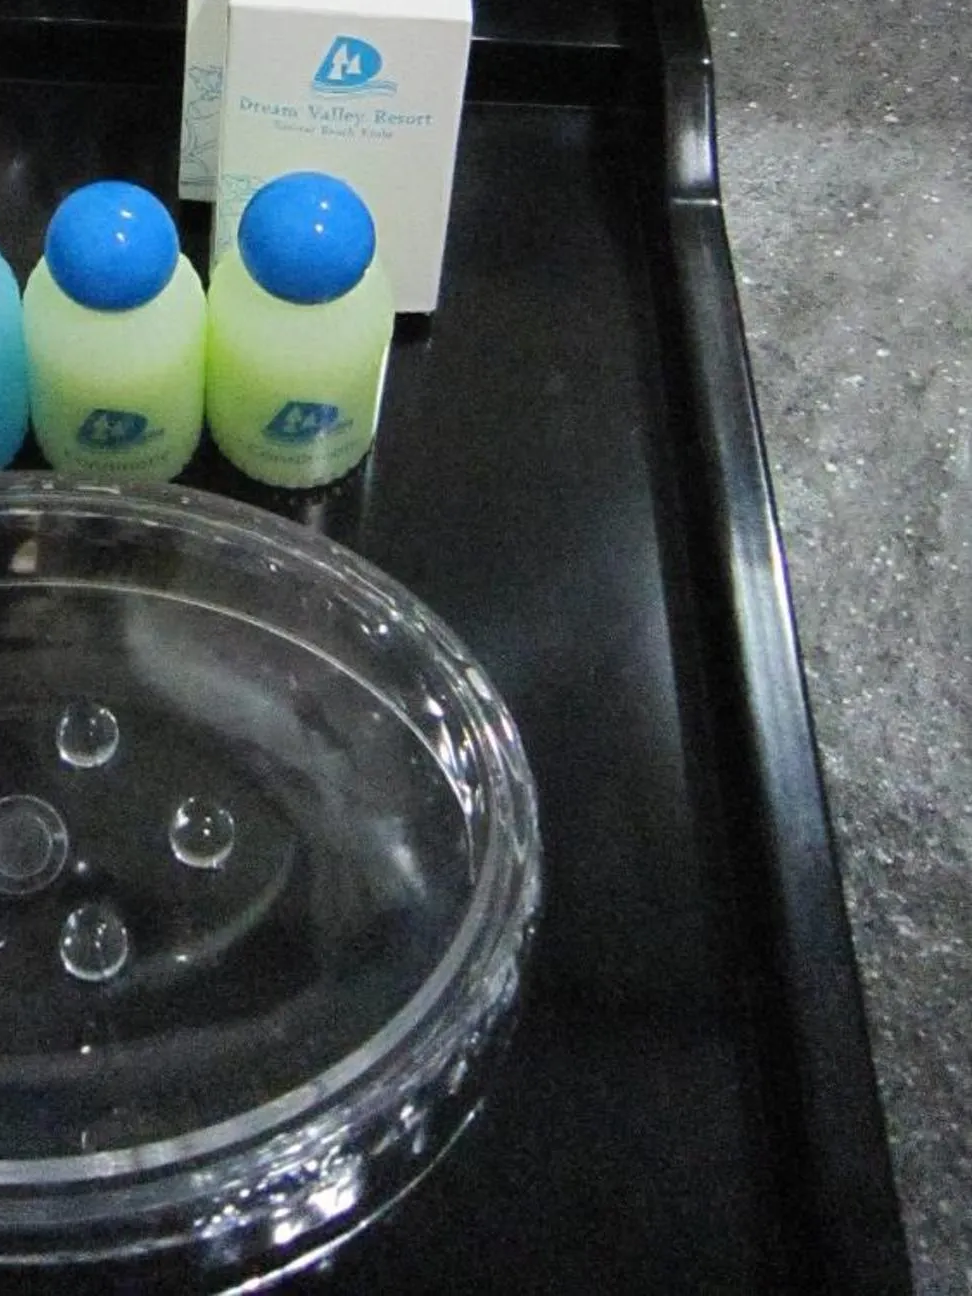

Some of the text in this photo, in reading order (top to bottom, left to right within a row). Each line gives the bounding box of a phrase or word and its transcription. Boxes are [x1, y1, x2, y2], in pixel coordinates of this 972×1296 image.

[240, 95, 433, 129] Dream Valley Resort
